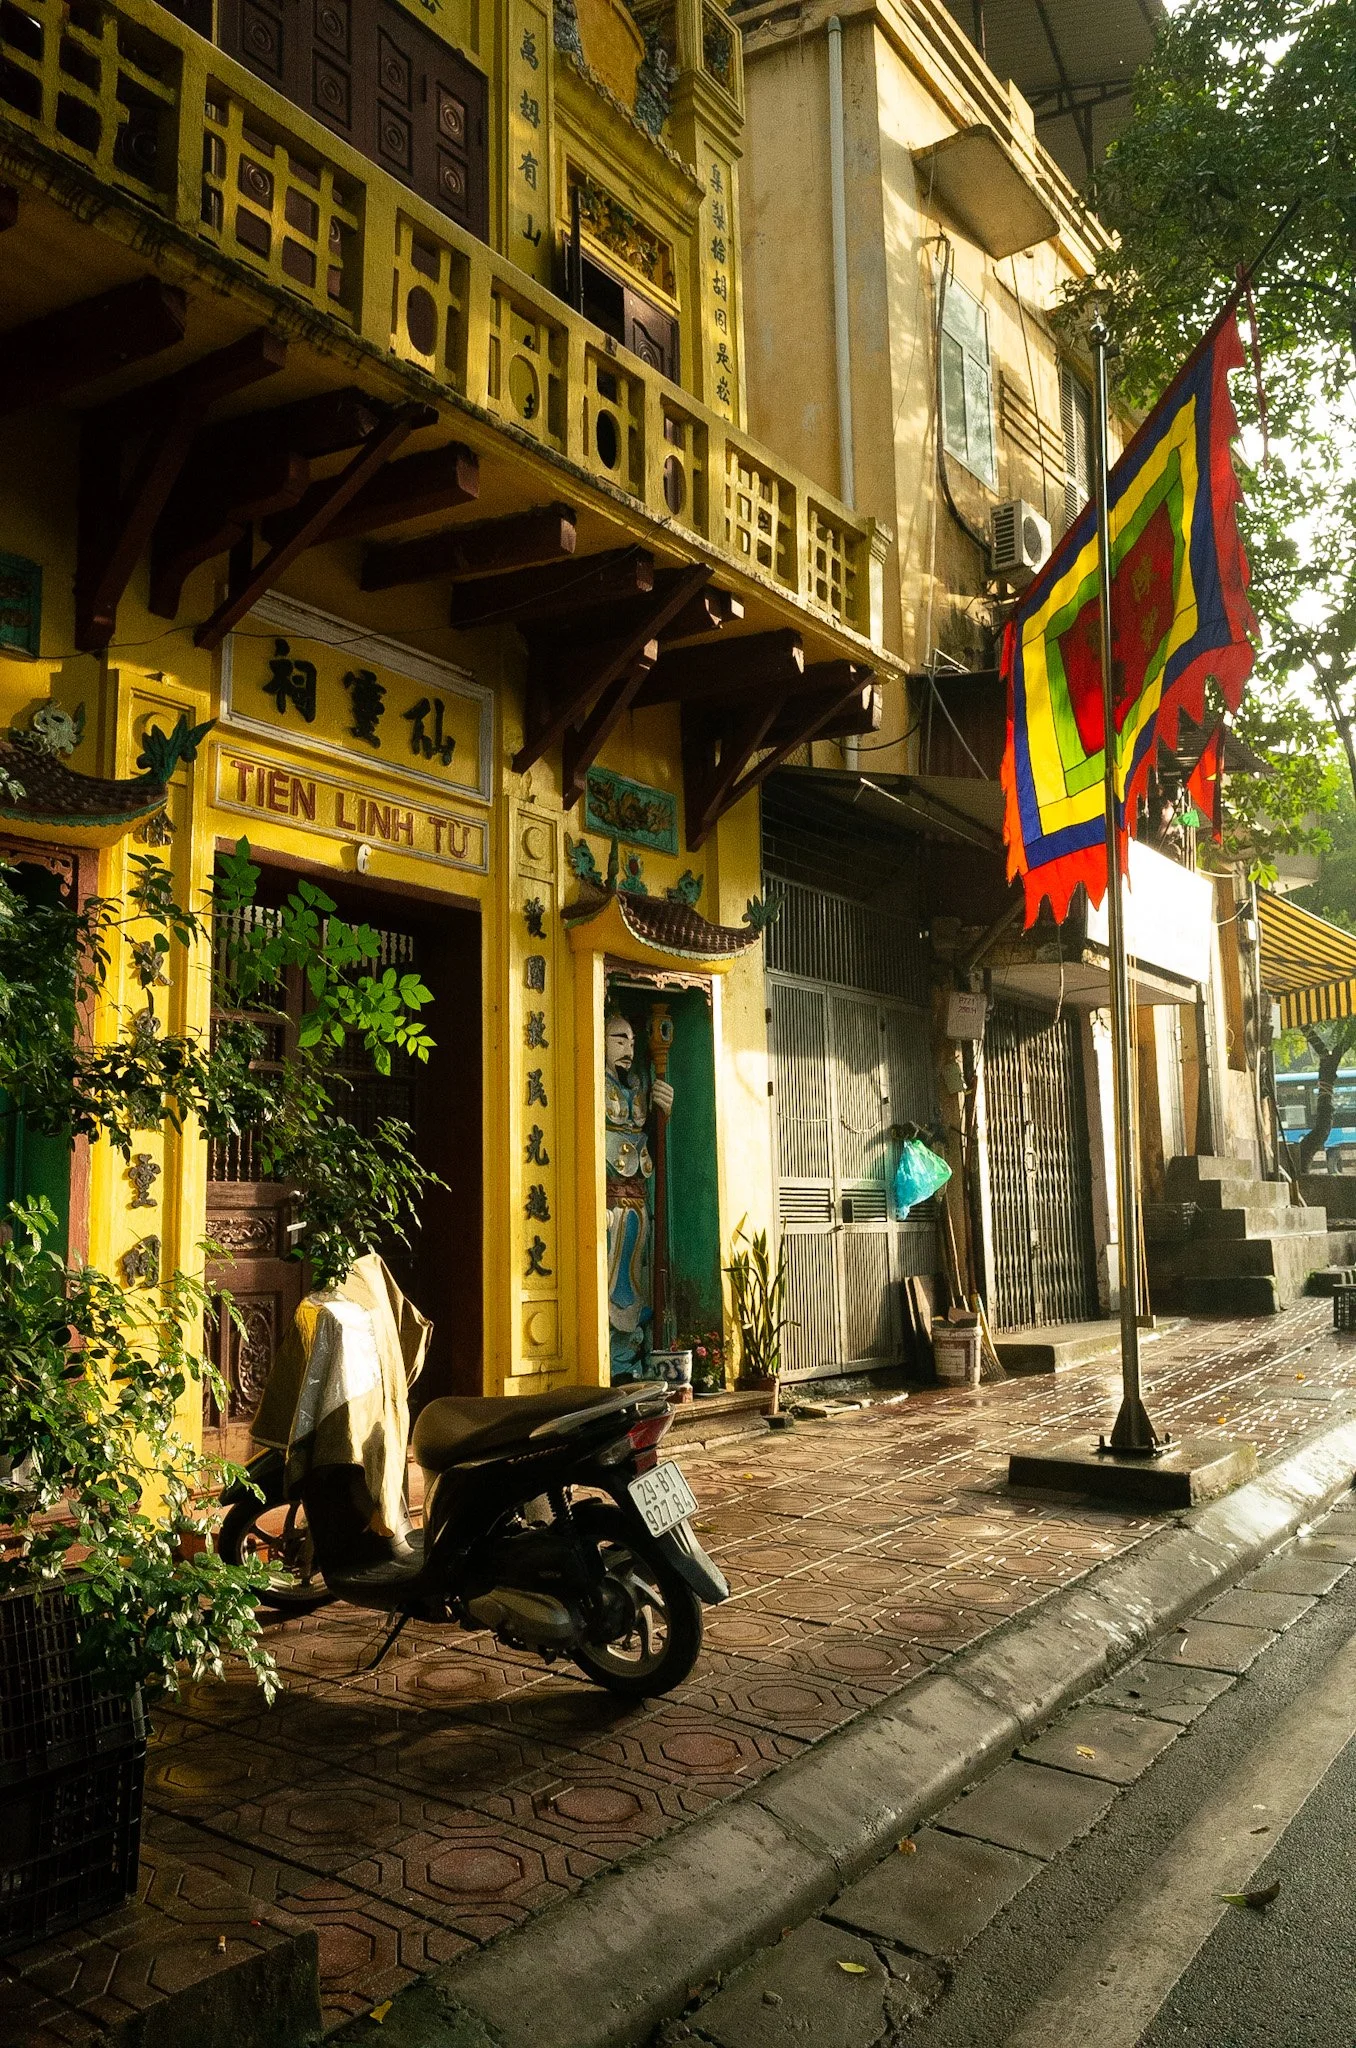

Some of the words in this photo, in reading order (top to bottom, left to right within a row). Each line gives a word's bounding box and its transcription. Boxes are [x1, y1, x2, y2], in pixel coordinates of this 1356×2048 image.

[231, 760, 317, 821] TIÊN
[335, 792, 414, 846] LINH
[428, 816, 470, 859] TỪ
[637, 1467, 677, 1506] 29-B1
[645, 1488, 693, 1532] 927.84
